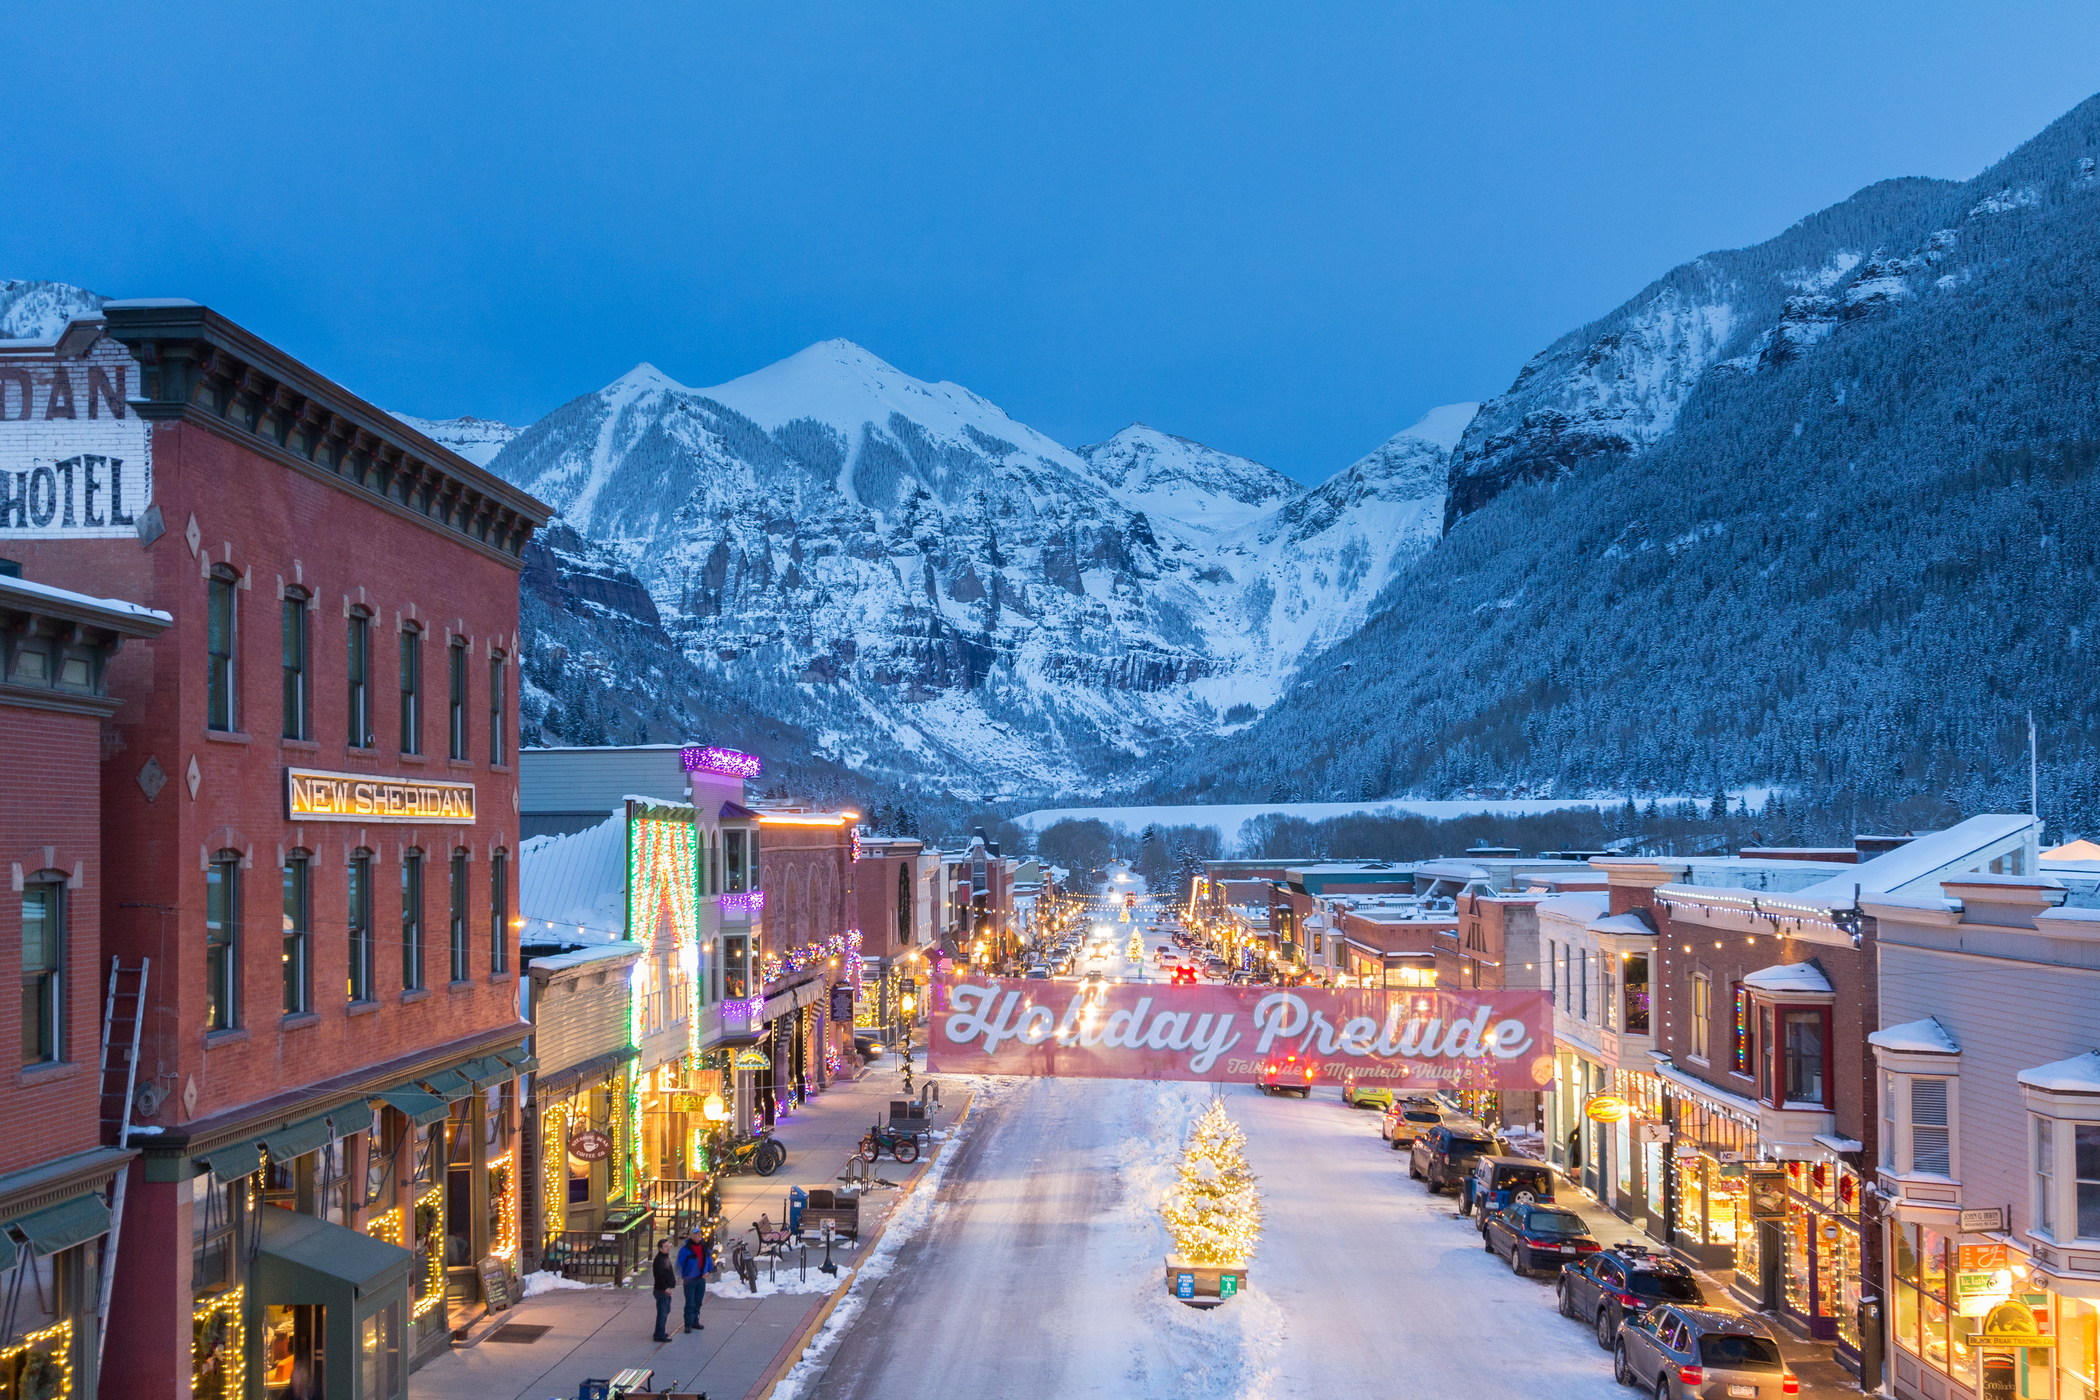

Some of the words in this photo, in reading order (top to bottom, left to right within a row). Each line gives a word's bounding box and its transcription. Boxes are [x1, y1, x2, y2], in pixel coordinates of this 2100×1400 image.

[0, 454, 134, 528] HOTEL
[292, 778, 349, 813] NEW
[945, 984, 1241, 1075] Holiday
[1253, 993, 1534, 1059] Prelude
[1324, 1062, 1409, 1080] Mountain
[1411, 1063, 1475, 1080] Village
[571, 1135, 595, 1147] STEAMING
[596, 1136, 609, 1148] BEAN
[576, 1150, 595, 1158] COFFEE
[1983, 1211, 1998, 1220] IRWIN
[1870, 1307, 1878, 1317] P
